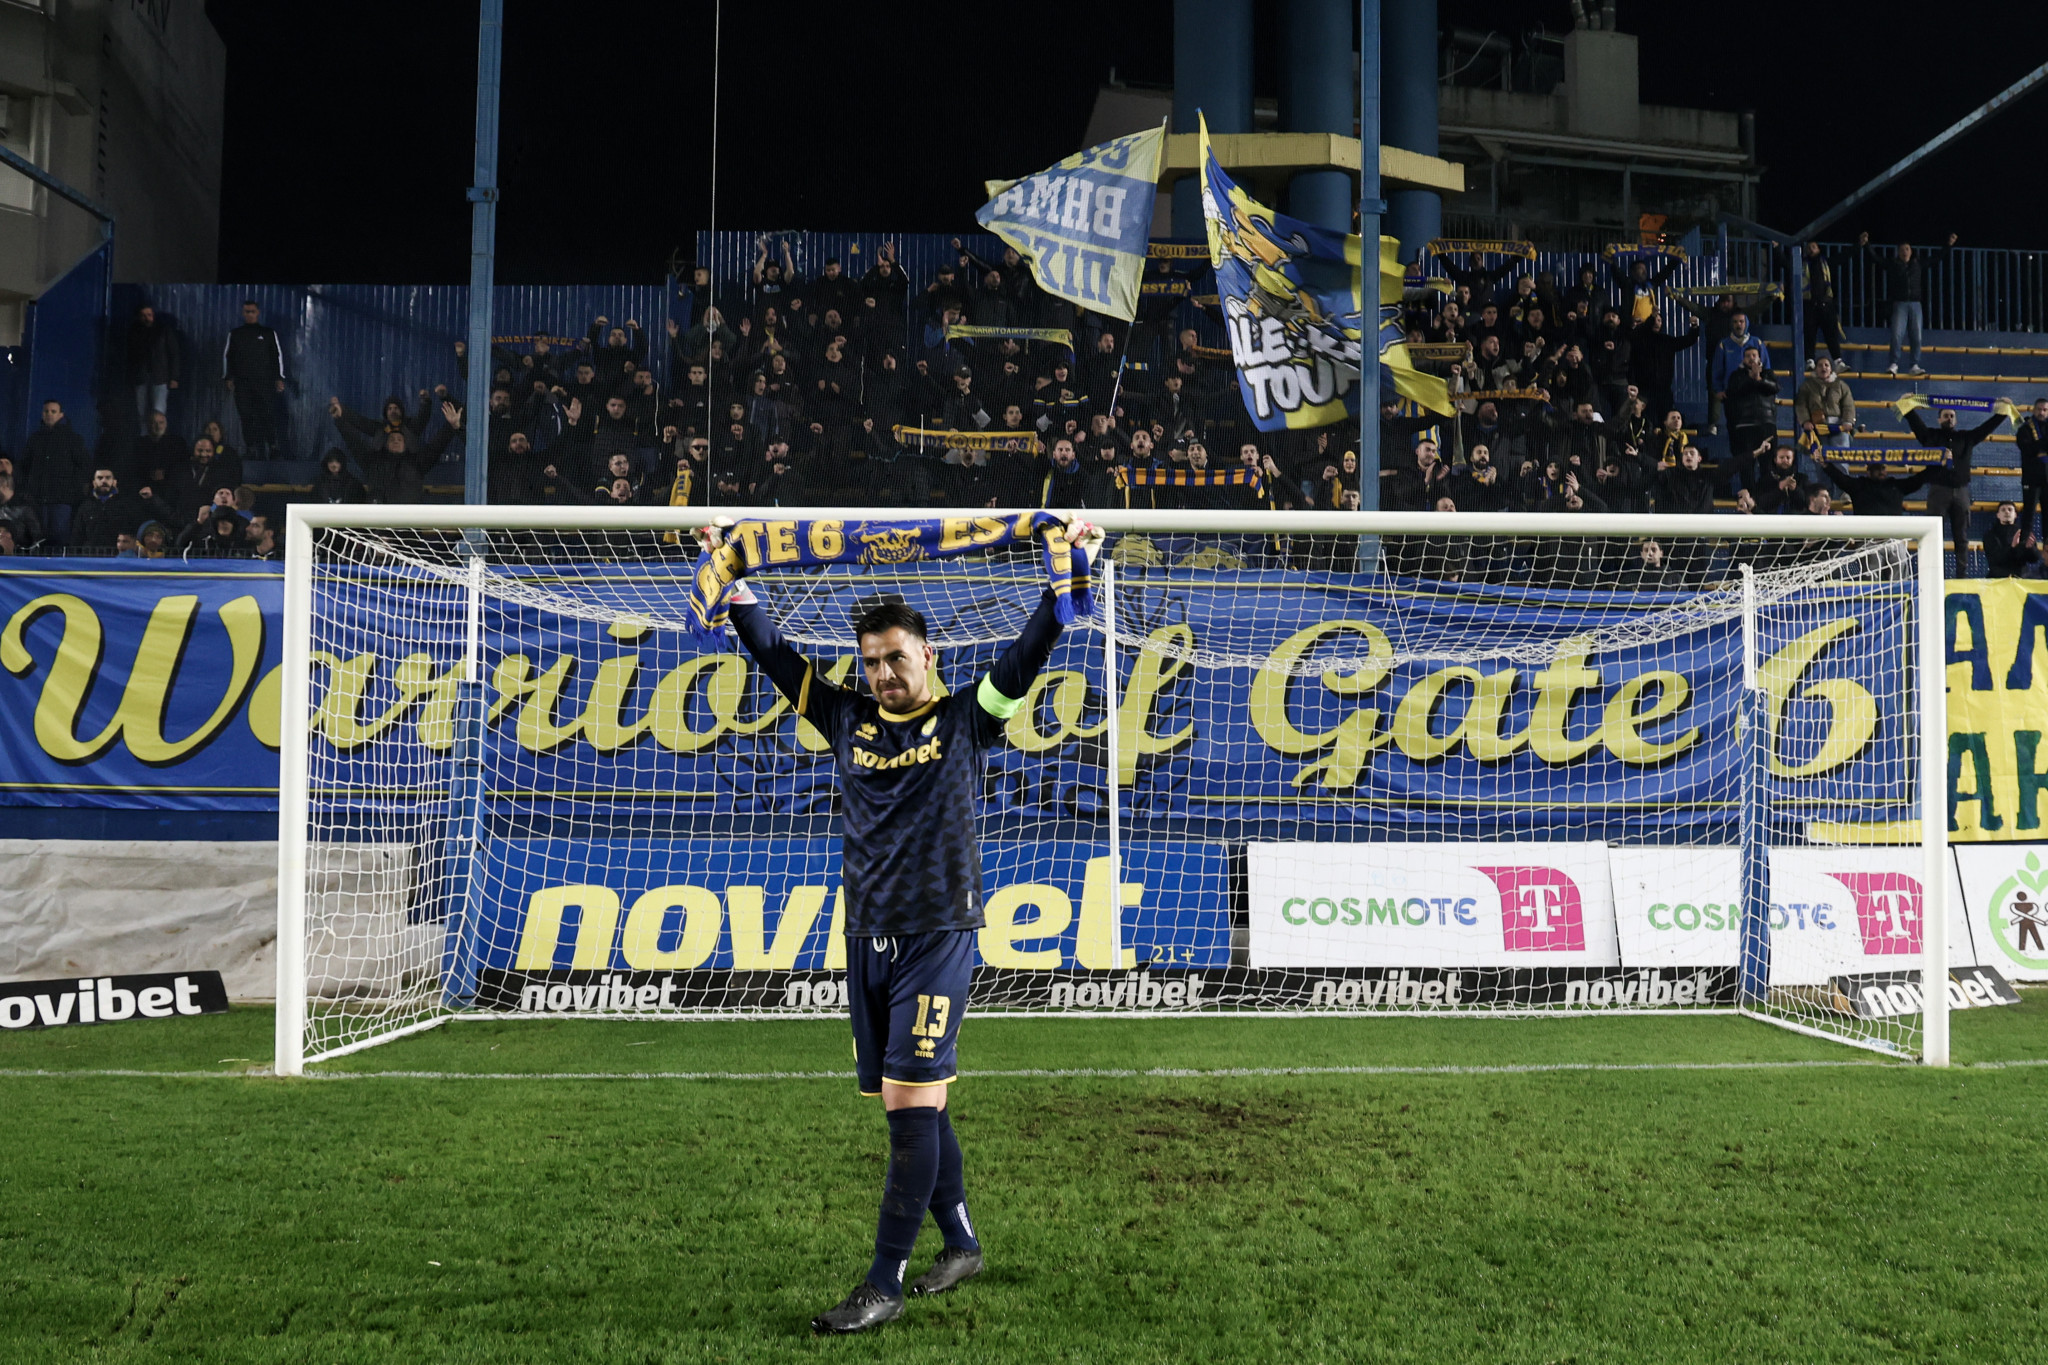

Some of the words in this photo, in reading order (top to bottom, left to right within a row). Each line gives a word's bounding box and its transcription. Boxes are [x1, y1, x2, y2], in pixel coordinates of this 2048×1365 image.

[1826, 449, 1882, 461] ALWAYS
[1885, 450, 1904, 461] ON
[1907, 450, 1943, 462] TOUR
[809, 519, 846, 560] 6
[1004, 623, 1194, 785] of
[1250, 619, 1699, 789] Gate
[1734, 617, 1878, 778] 6
[514, 854, 1144, 971] novet
[1281, 897, 1478, 927] COSMOTE
[520, 974, 678, 1012] novibet
[1050, 971, 1205, 1008] novibet
[1312, 969, 1463, 1006] novibet
[1565, 971, 1713, 1006] novibet
[1861, 969, 2008, 1018] novet
[911, 993, 951, 1038] 13
